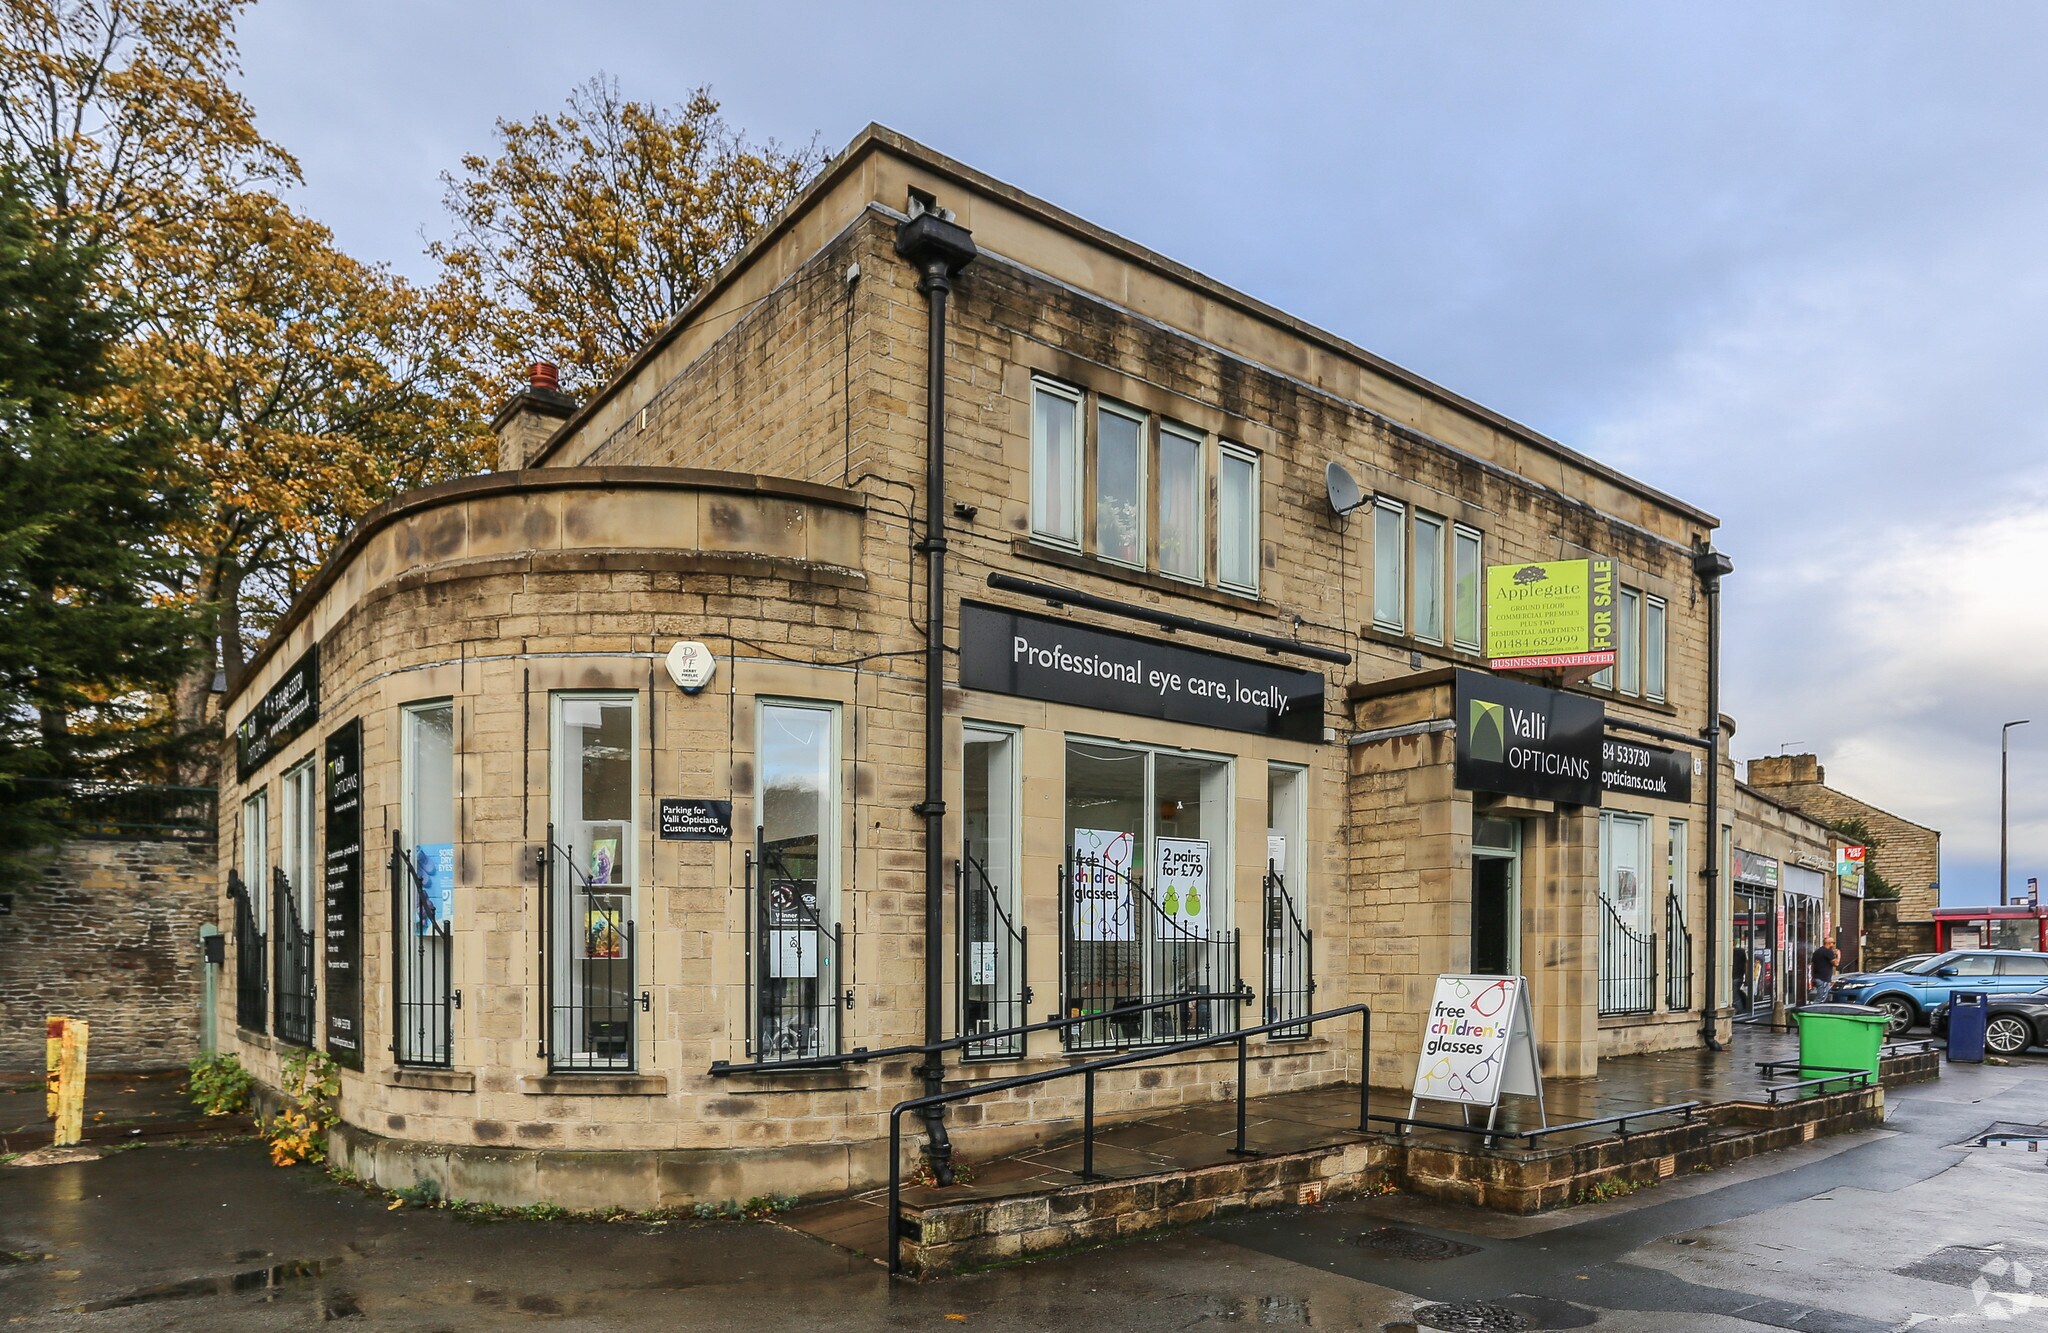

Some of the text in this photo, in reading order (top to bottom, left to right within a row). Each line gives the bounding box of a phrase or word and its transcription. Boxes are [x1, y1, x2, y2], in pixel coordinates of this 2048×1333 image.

[1496, 583, 1581, 601] Applegate
[1510, 603, 1540, 612] GROUND
[1594, 560, 1612, 648] FOR SALE
[1496, 610, 1580, 620] COMMERCIAL PREMISES
[1491, 626, 1585, 637] RESIDENTIAL APARTMENTS
[1495, 635, 1578, 649] 01484 682999
[1491, 653, 1614, 668] BUSINESSES UNAFFECTED
[1013, 636, 1290, 716] Professional eye care, locally.
[1509, 708, 1546, 740] Valli
[1508, 747, 1590, 780] OPTICIANS
[1617, 745, 1650, 767] 533730
[663, 805, 706, 816] Parking for
[662, 814, 718, 825] Valli Opticians
[663, 824, 728, 835] Customers Only
[438, 848, 454, 857] SORE
[440, 856, 453, 864] DRY
[1163, 848, 1201, 866] 2 pairs
[438, 864, 453, 872] EYES
[1162, 861, 1204, 878] for £79
[1435, 1001, 1465, 1018] free
[1431, 1018, 1505, 1039] children's
[1427, 1035, 1484, 1056] glasses
